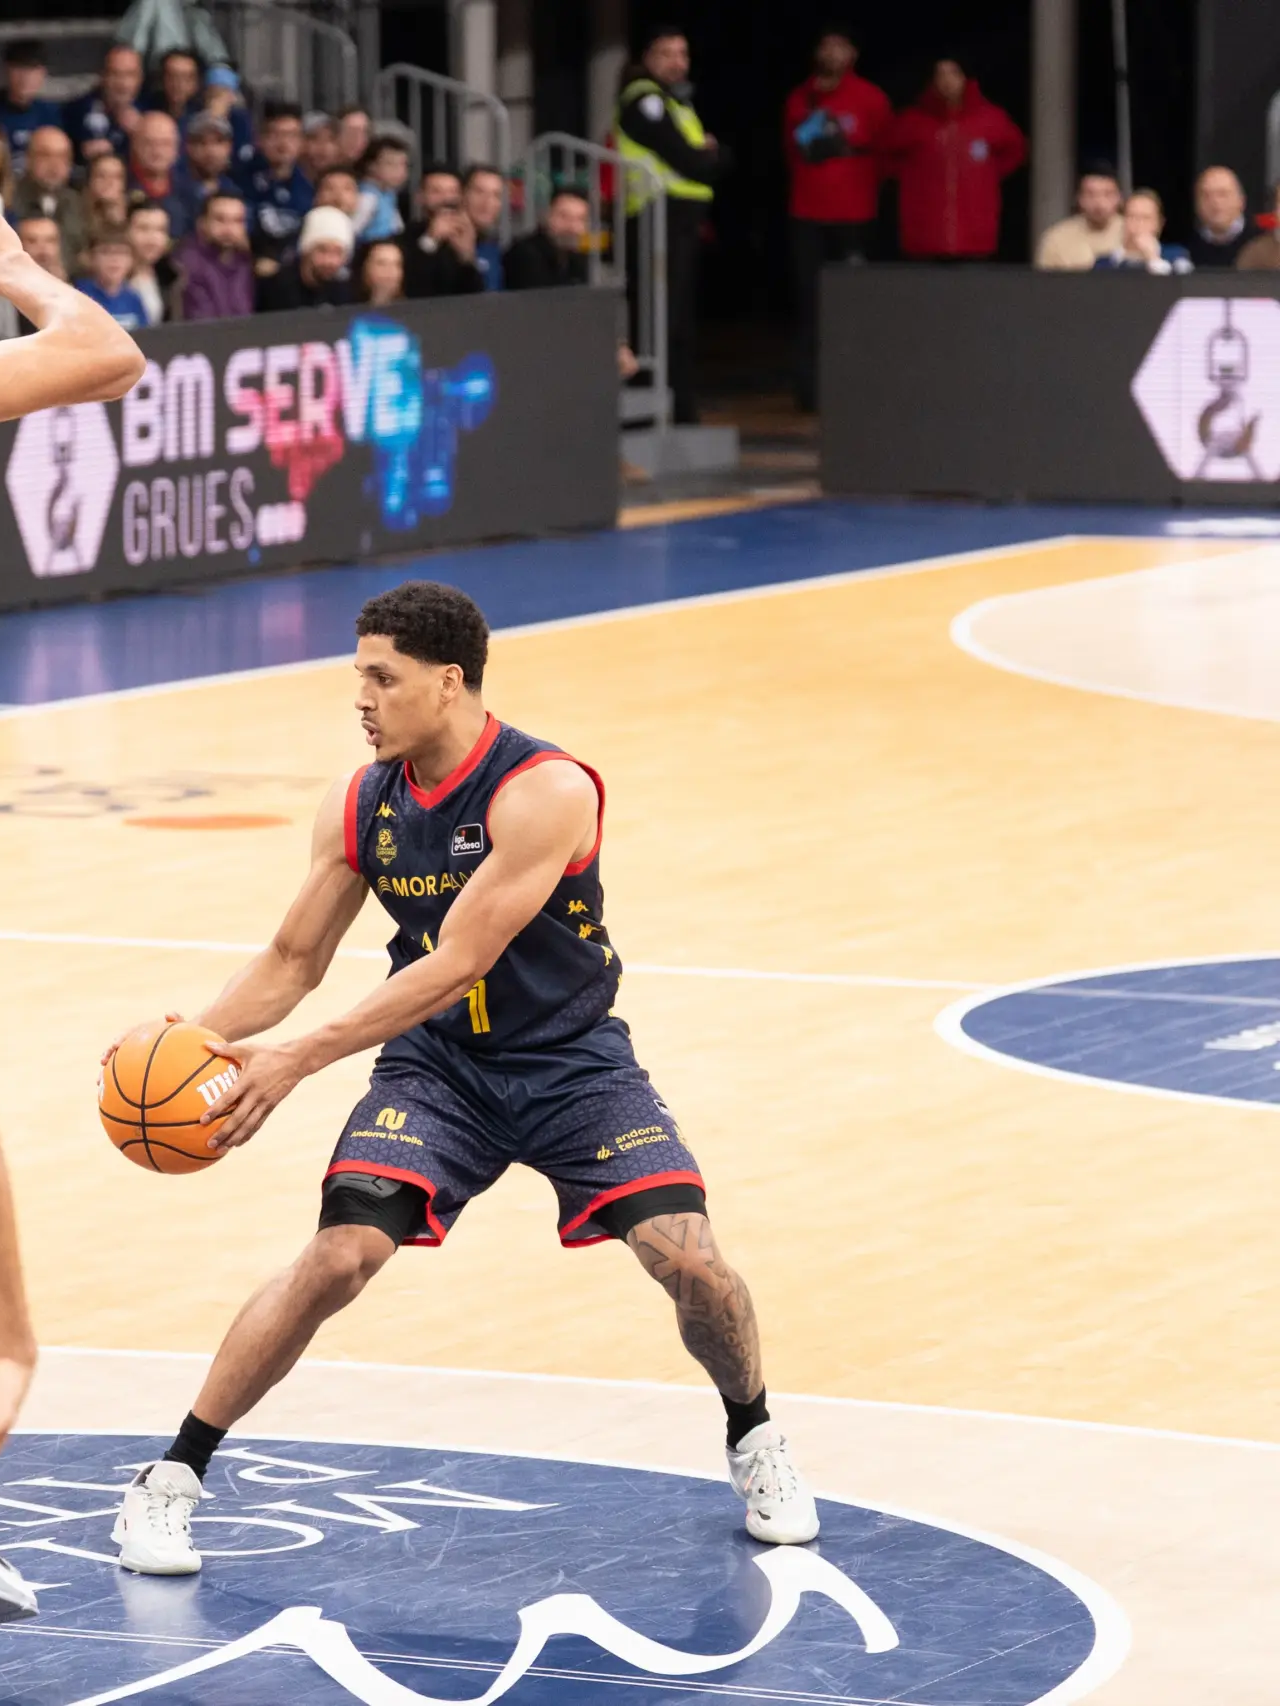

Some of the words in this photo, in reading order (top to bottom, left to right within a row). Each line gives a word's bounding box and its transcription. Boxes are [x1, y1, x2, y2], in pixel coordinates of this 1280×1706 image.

[122, 354, 215, 467] BM
[123, 467, 255, 567] GRUES
[454, 841, 481, 852] endesa
[350, 1130, 387, 1139] Andorra
[388, 1132, 398, 1141] la
[400, 1133, 424, 1147] Vella
[615, 1125, 663, 1144] andorra
[618, 1134, 670, 1152] telecom
